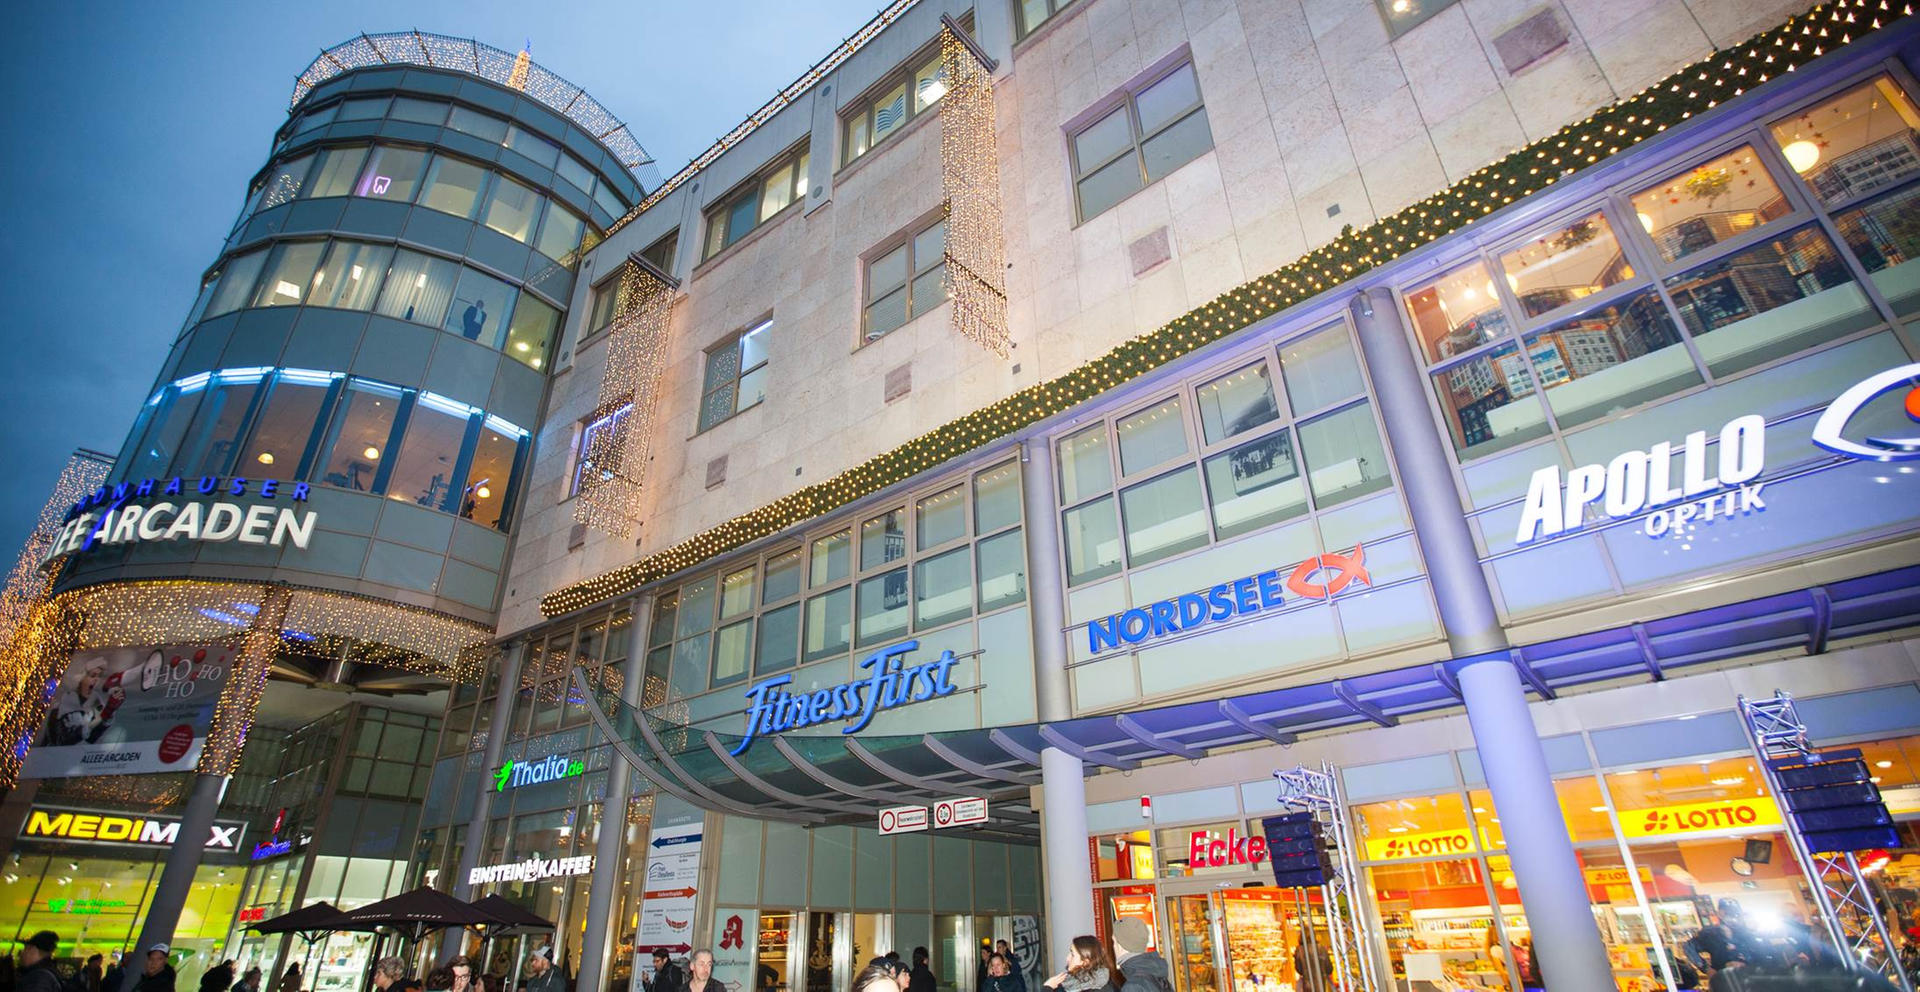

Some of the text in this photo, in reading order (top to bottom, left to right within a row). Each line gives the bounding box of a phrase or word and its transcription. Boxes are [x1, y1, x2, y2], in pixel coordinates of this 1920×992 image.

[1515, 414, 1766, 546] APOLLO
[84, 500, 318, 550] ARCADEN
[1645, 484, 1767, 540] OPTIK
[1087, 569, 1286, 654] NORDSEE
[165, 681, 195, 698] HO
[197, 664, 222, 681] HO
[27, 810, 238, 848] MEDIMX
[1674, 805, 1757, 830] LOTTO
[1189, 827, 1272, 869] Ecke
[1407, 834, 1468, 856] LOTTO
[468, 855, 592, 885] EINSTEIN KAFFEE
